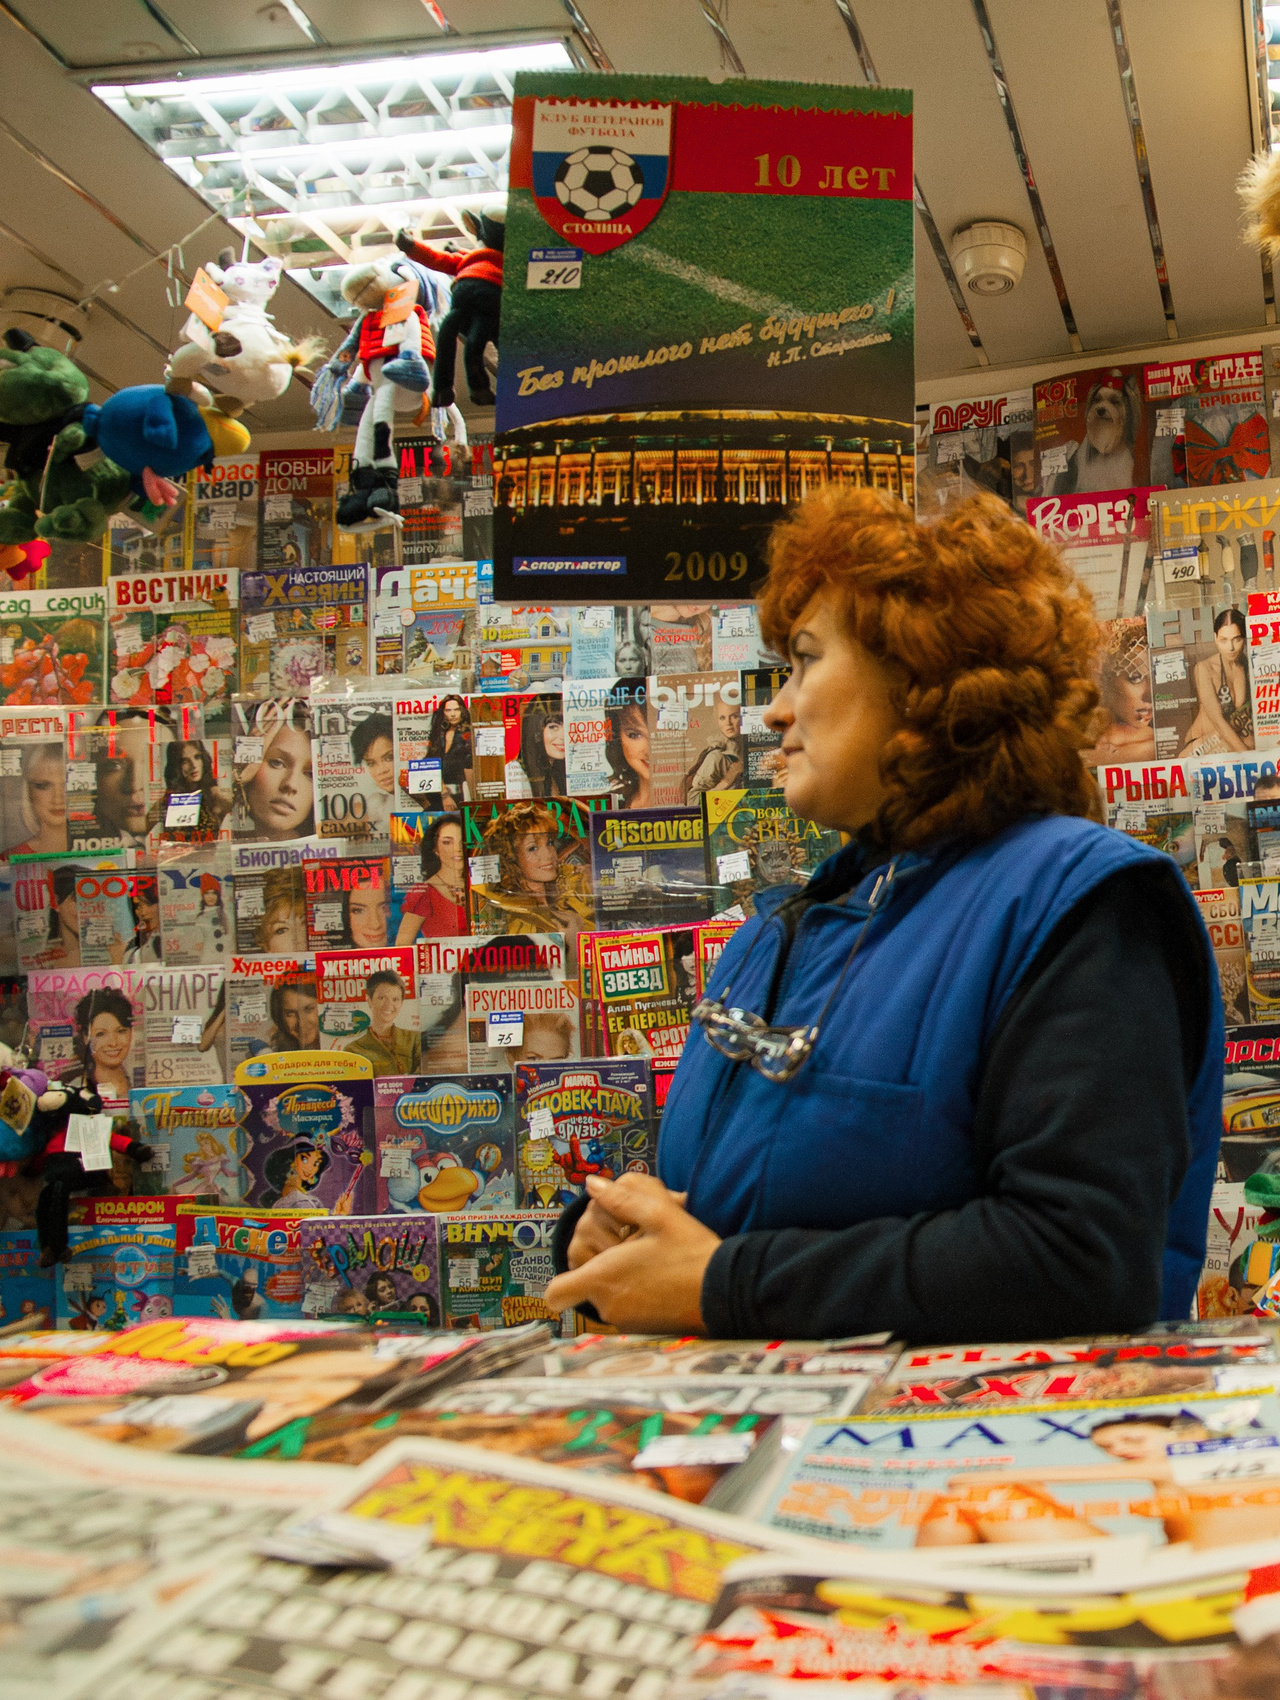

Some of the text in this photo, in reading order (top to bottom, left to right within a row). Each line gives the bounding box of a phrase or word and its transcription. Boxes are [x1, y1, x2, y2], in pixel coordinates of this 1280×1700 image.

[540, 113, 664, 128] КЛУБ ВЕТЕРАНОВ
[567, 125, 636, 139] ФУТБОЛА
[753, 153, 896, 191] 10 лет
[562, 222, 632, 236] СТОЛИЦА
[540, 266, 580, 284] 210
[518, 368, 564, 396] Без
[573, 340, 693, 388] прошлого
[700, 325, 753, 354] нет
[758, 302, 874, 342] будущего
[1200, 391, 1262, 407] КРИЗИС
[265, 477, 308, 494] ДОМ
[289, 567, 365, 582] НАСТОЯЩИЙ
[664, 551, 748, 581] 2009
[1172, 565, 1195, 580] 490
[1257, 699, 1280, 714] ЯН
[569, 719, 611, 733] ДОЛОЙ
[419, 780, 433, 791] 95
[1104, 764, 1187, 803] РЫБА
[319, 793, 366, 821] 100
[320, 820, 377, 835] самых
[239, 845, 338, 868] Биография
[601, 944, 660, 969] ТАЙНЫ
[232, 957, 298, 976] Худеем
[322, 956, 400, 979] ЖЕНСКОЕ
[605, 970, 662, 993] ЗВЕЗД
[145, 972, 219, 1012] SHAPE
[472, 987, 575, 1012] PSYCHOLOGIES
[608, 1003, 631, 1013] Алла
[608, 1006, 689, 1034] ЕЕ ПЕРВЫЕ
[272, 1061, 312, 1070] Подарок
[333, 1060, 357, 1068] тебя!
[565, 1075, 596, 1087] MARVEL
[400, 1099, 497, 1126] СМЕШАРИКИ
[95, 1201, 165, 1216] ПОДАРОК
